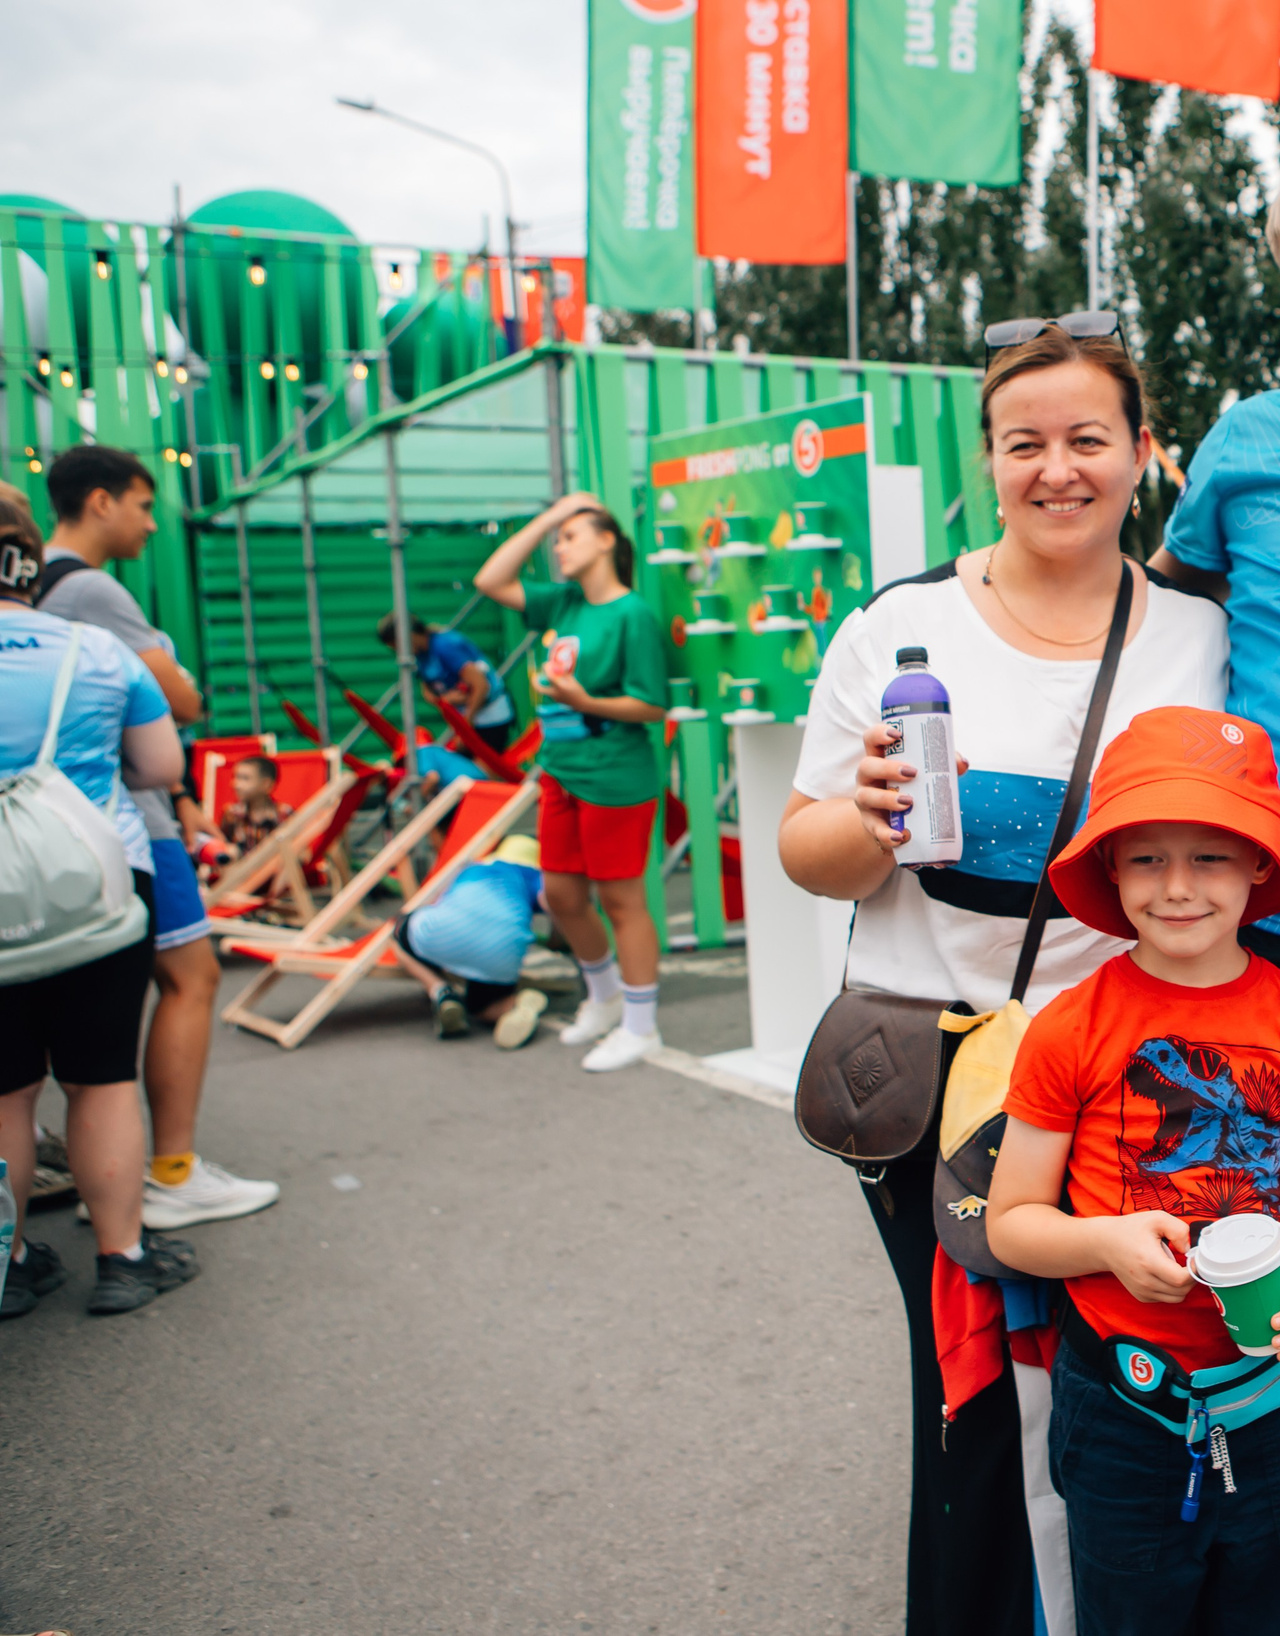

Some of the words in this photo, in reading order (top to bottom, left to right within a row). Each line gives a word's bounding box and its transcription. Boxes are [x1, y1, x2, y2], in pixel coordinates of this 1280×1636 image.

[620, 45, 652, 231] выручает!
[654, 45, 690, 231] Пятёрочка
[738, 51, 773, 180] минут
